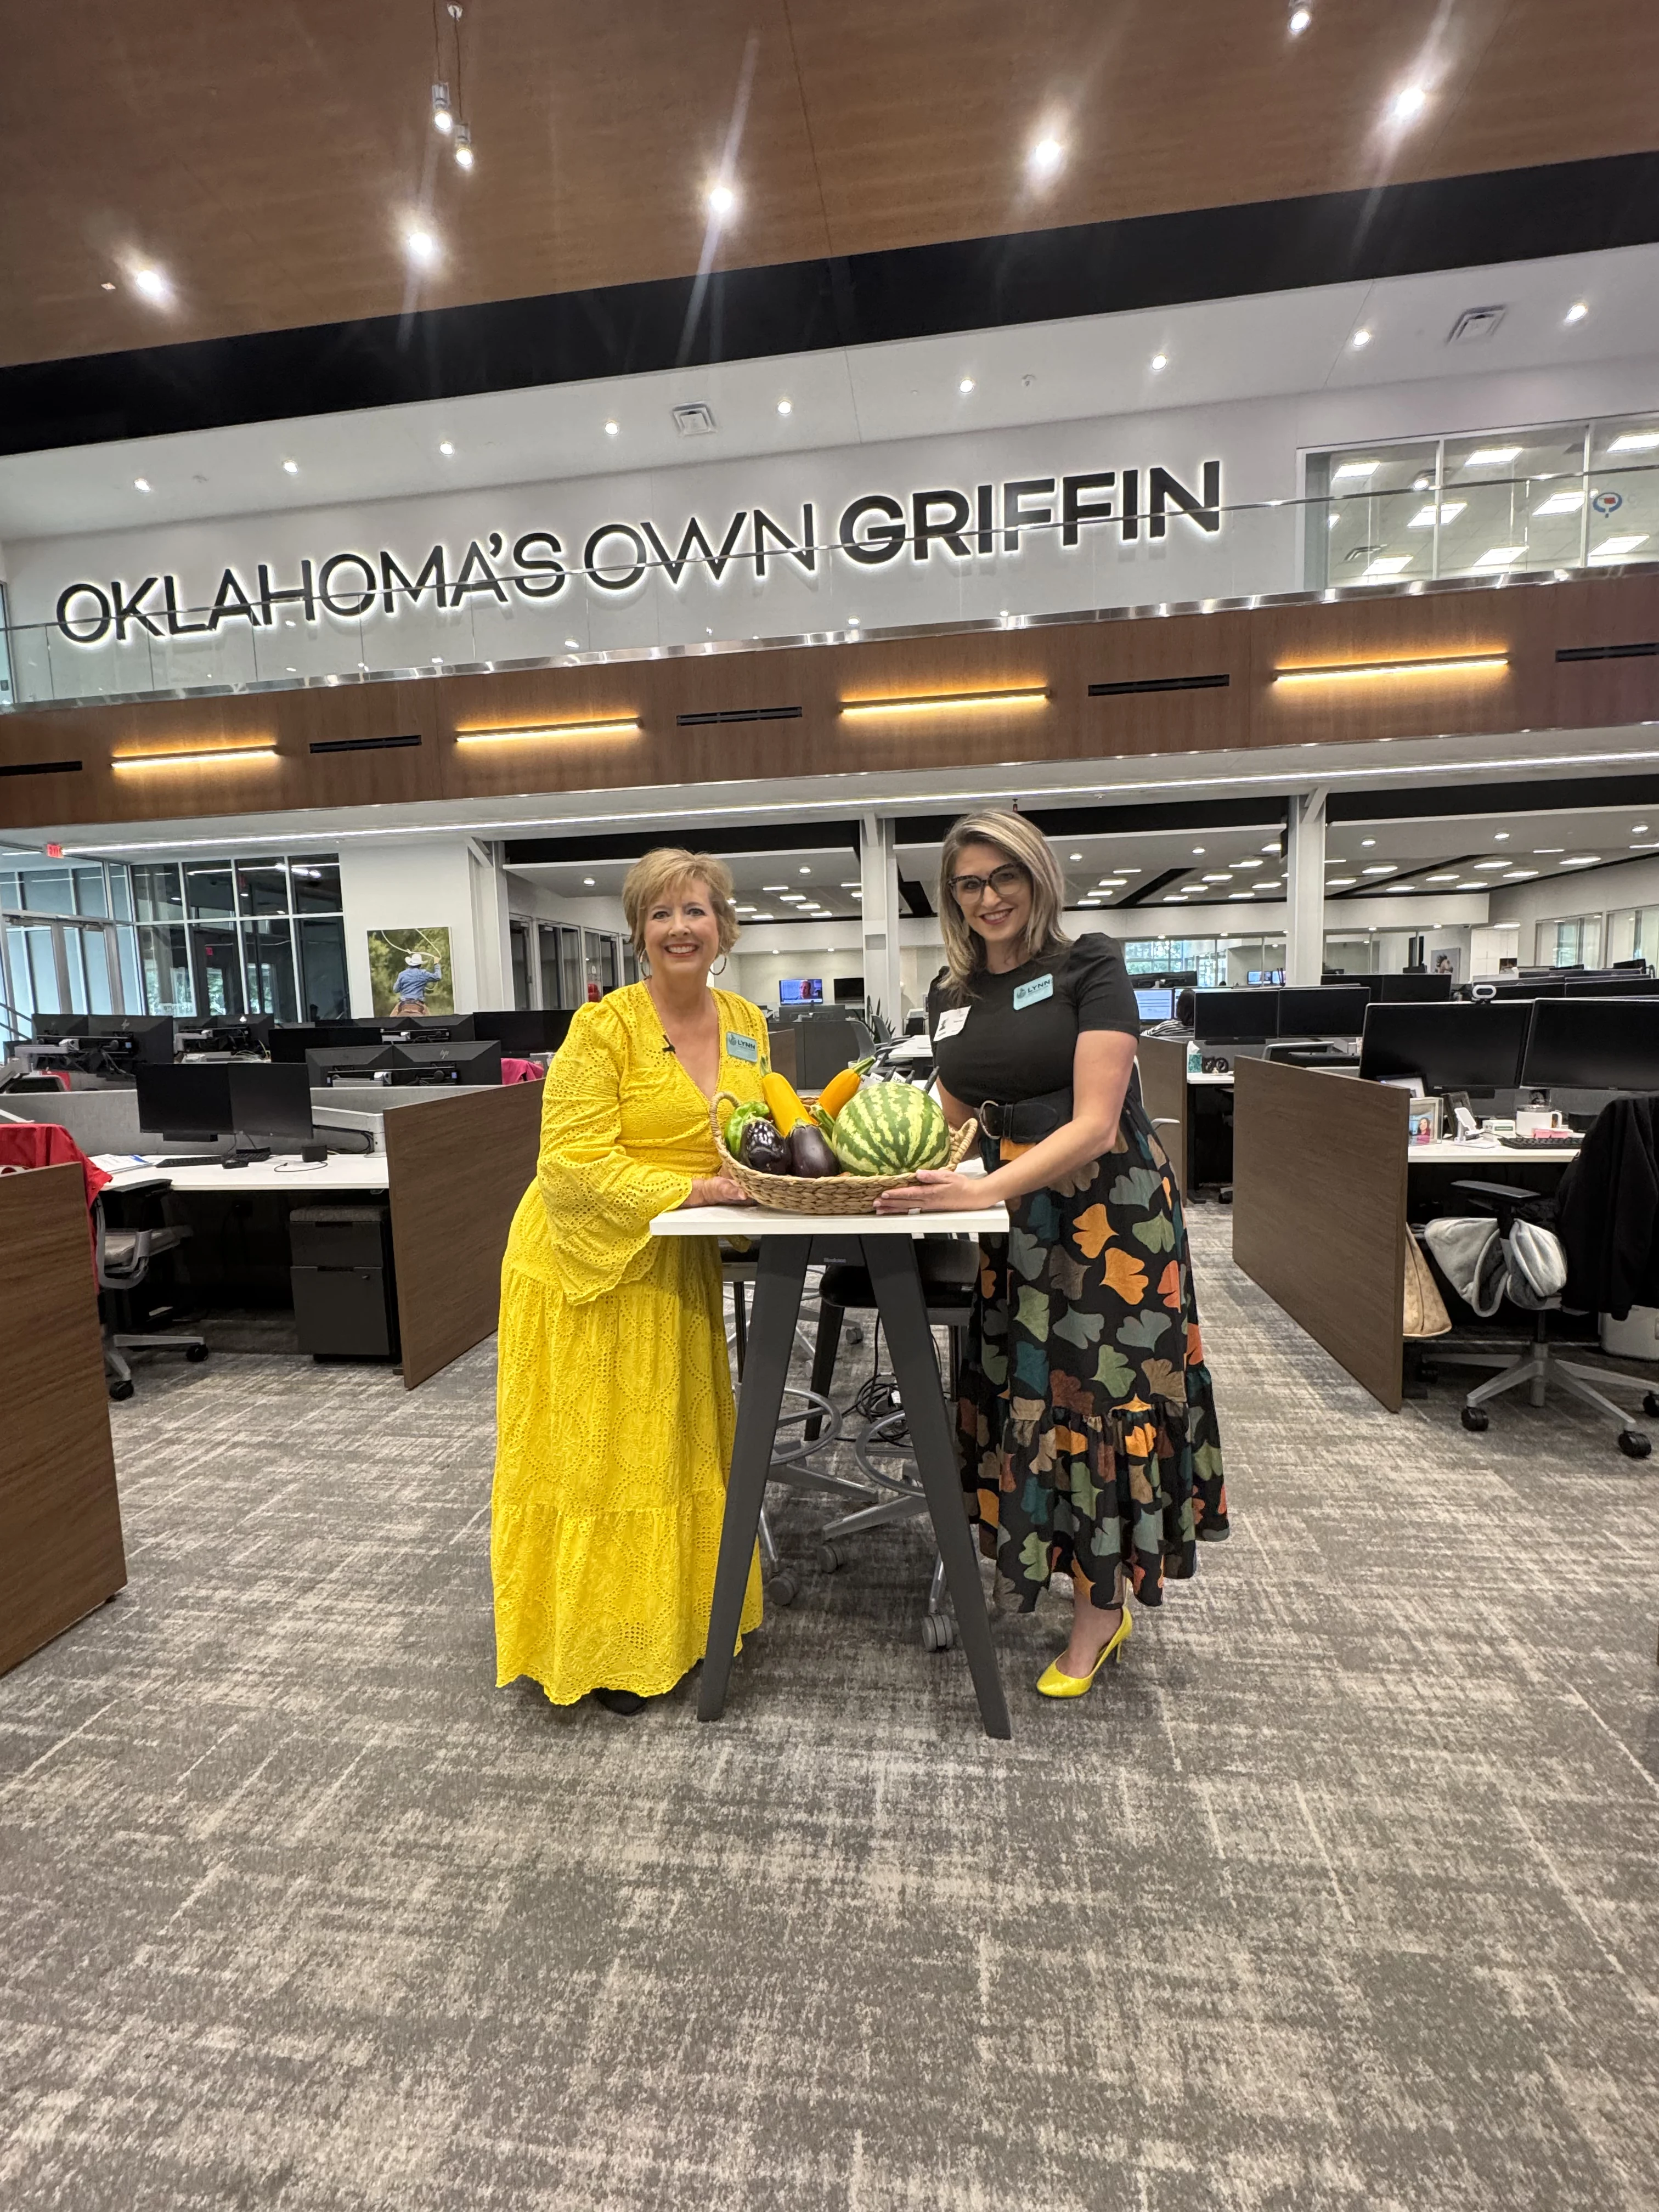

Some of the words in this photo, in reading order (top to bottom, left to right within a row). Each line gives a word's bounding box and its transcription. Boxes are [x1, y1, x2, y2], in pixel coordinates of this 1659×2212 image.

[57, 533, 566, 644] OKLAHOMA’S
[584, 504, 815, 590] OWN
[839, 461, 1220, 564] GRIFFIN
[1028, 979, 1050, 993] LYNN
[737, 1039, 755, 1049] LYNN
